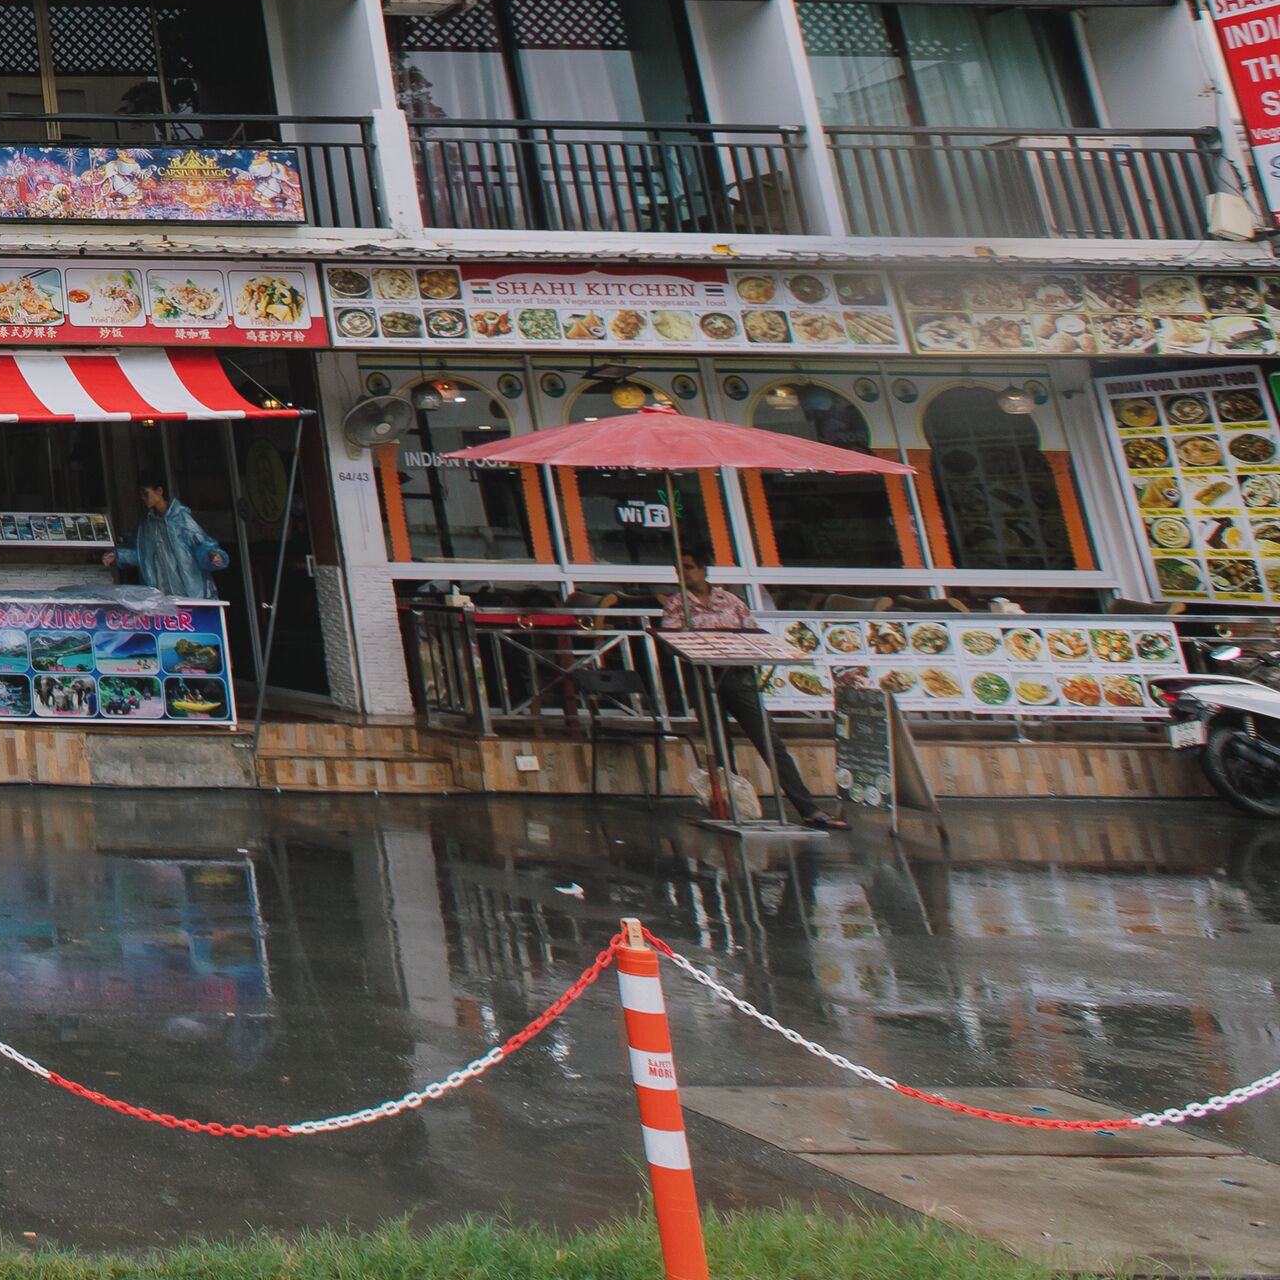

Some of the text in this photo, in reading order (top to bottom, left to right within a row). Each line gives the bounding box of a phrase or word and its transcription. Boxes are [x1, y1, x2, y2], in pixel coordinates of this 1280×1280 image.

[1223, 13, 1280, 49] INDI
[157, 167, 198, 178] CARNIVAL
[496, 281, 696, 297] SHAHI KITCHEN
[473, 296, 495, 304] Real
[705, 299, 727, 307] food
[100, 327, 124, 339] 炒饭
[338, 472, 369, 482] 64/43
[105, 609, 196, 632] CENTER
